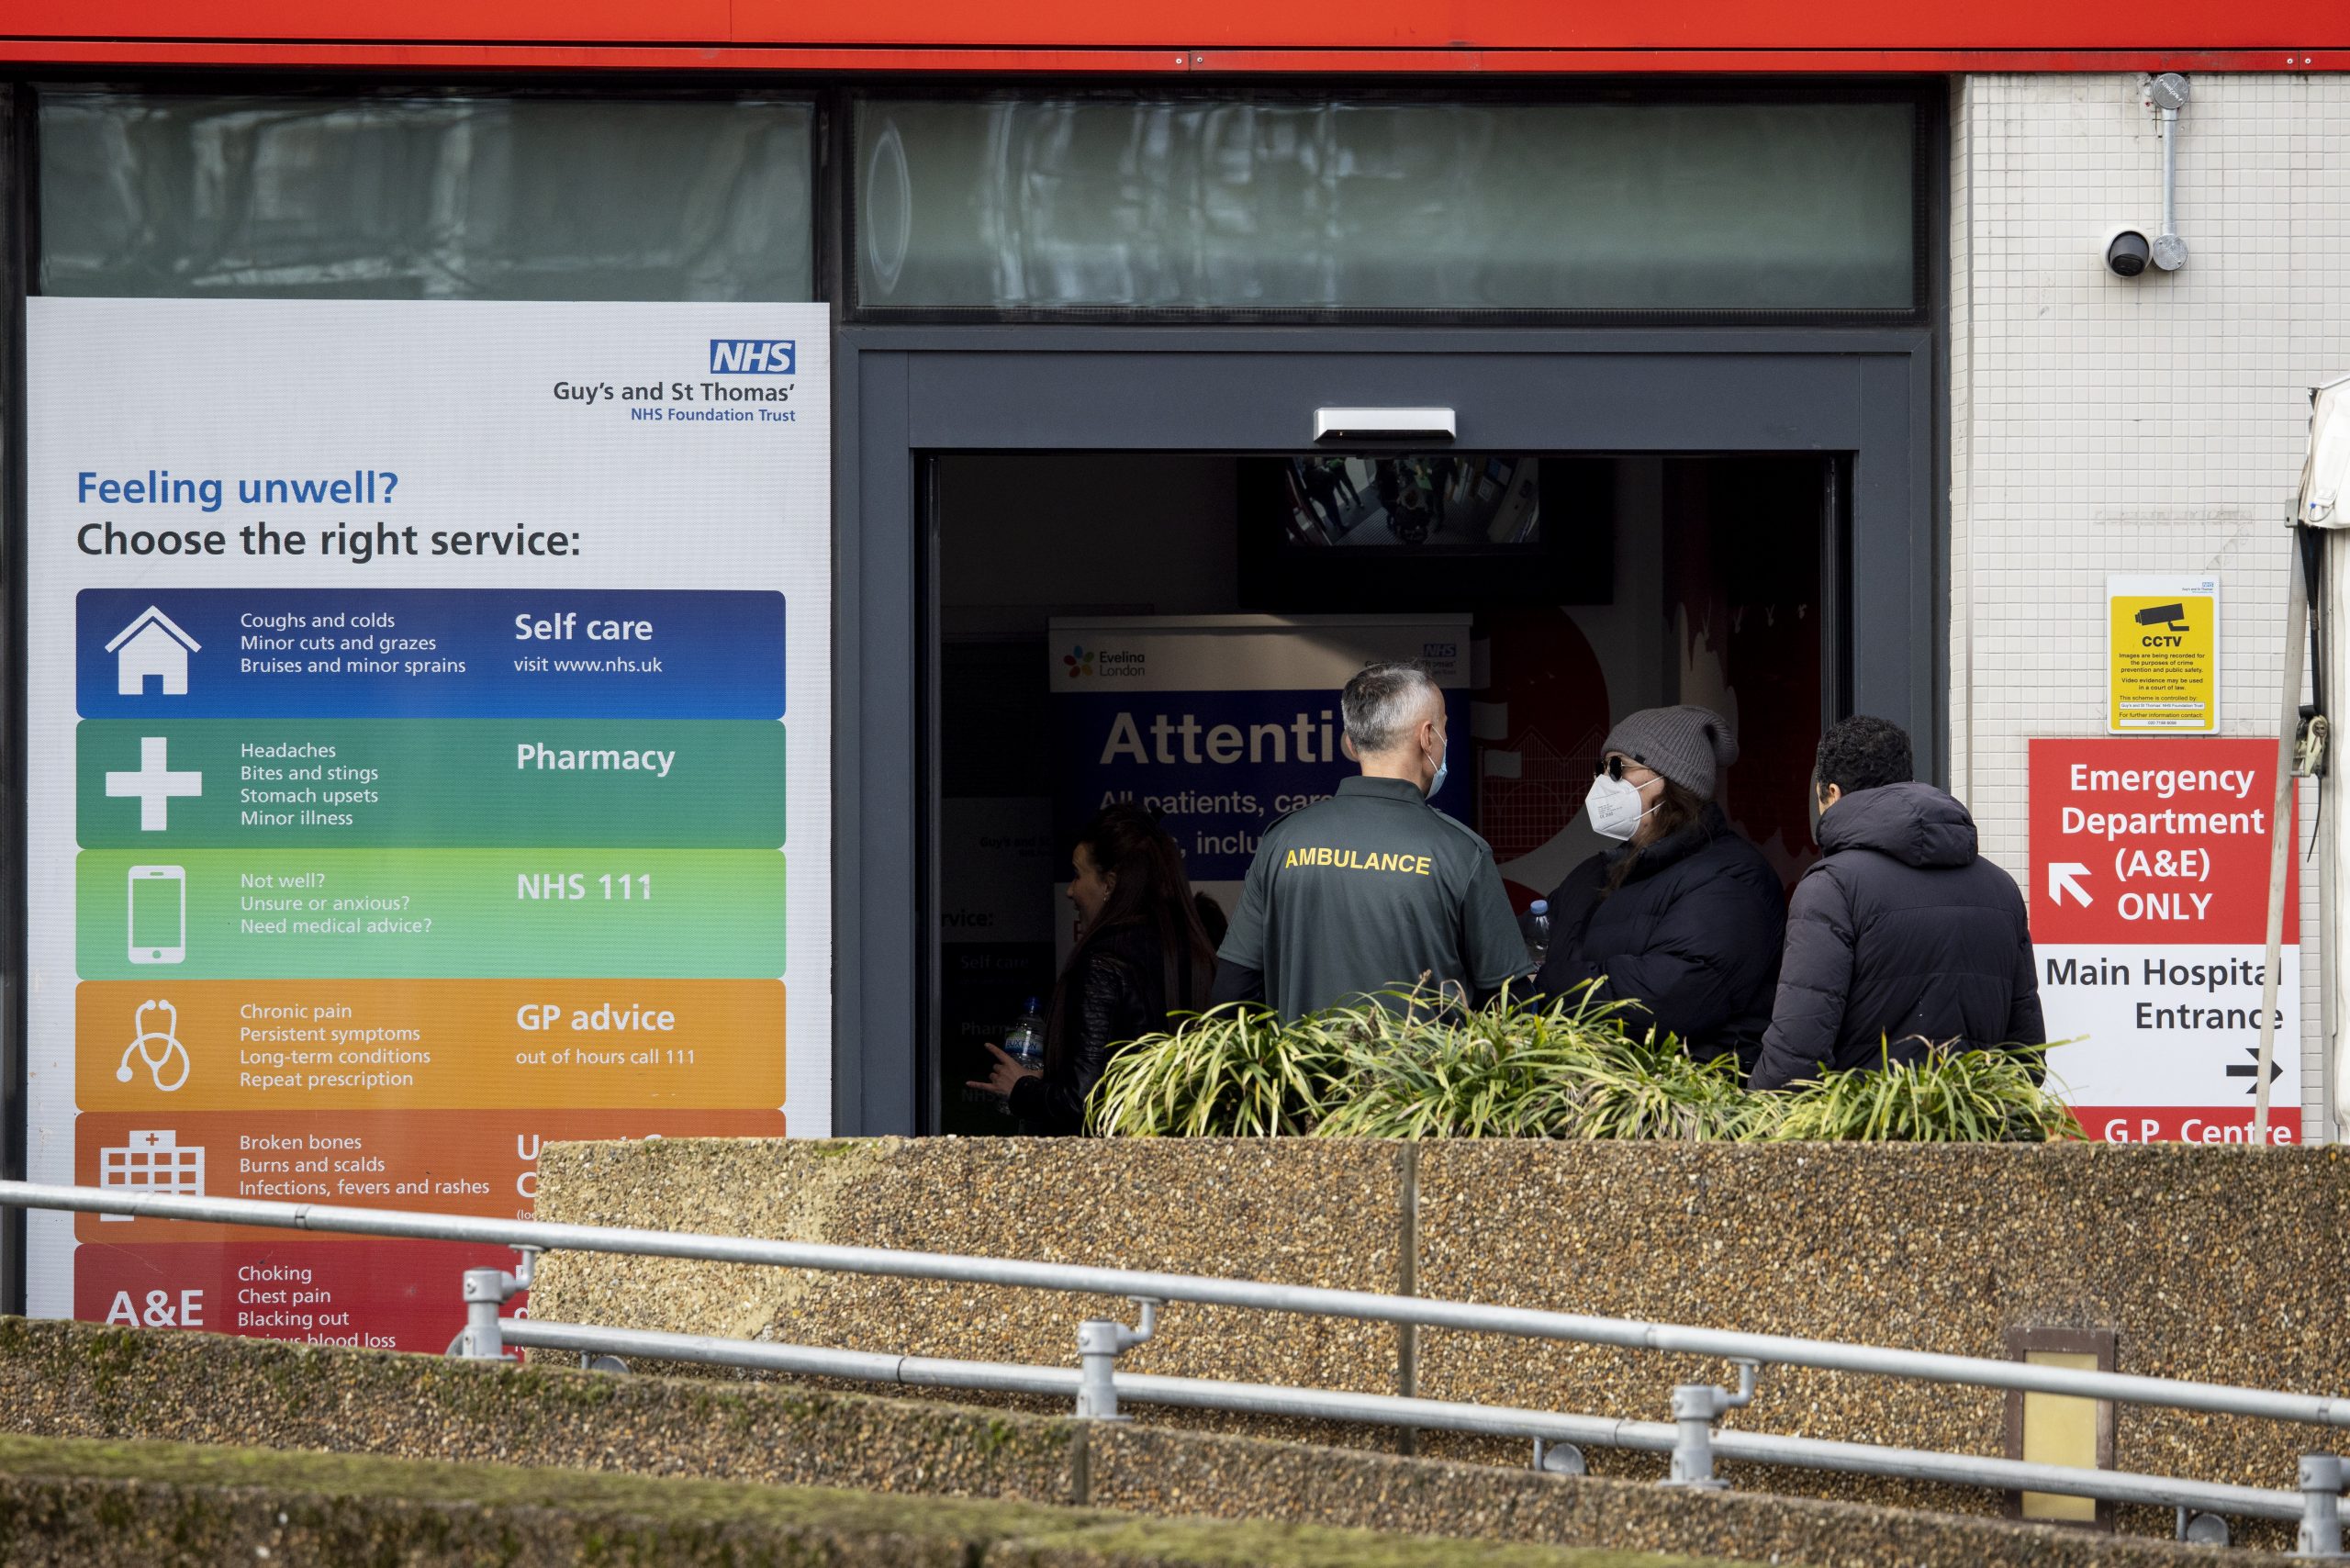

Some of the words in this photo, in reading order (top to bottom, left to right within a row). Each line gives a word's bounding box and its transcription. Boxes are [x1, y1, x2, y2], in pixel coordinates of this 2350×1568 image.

[712, 342, 792, 372] NHS
[554, 381, 613, 406] Guy's
[622, 381, 663, 400] and
[672, 382, 692, 401] St
[700, 382, 794, 402] Thomas'
[631, 408, 662, 420] NHS
[667, 408, 755, 421] Foundation
[759, 409, 795, 422] Trust
[78, 470, 221, 512] Feeling
[240, 470, 397, 504] unwell?
[78, 521, 225, 555] Choose
[241, 521, 305, 554] the
[322, 521, 417, 564] right
[432, 522, 578, 555] service:
[241, 612, 306, 633] Coughs
[312, 612, 345, 628] and
[351, 612, 395, 628] colds
[515, 612, 576, 640] Self
[588, 621, 652, 641] care
[241, 635, 292, 650] Minor
[300, 636, 334, 650] cuts
[341, 634, 374, 650] and
[380, 639, 435, 655] grazes
[1426, 644, 1455, 655] NHS
[2143, 636, 2181, 647] CCTV
[241, 657, 301, 673] Bruises
[308, 656, 341, 673] and
[348, 657, 397, 673] minor
[405, 657, 465, 678] sprains
[515, 655, 549, 673] visit
[554, 656, 662, 674] www.nhs.uk
[1100, 652, 1146, 664] Evelina
[1100, 666, 1146, 678] London
[241, 743, 336, 757] Headaches
[518, 742, 674, 778] Pharmacy
[241, 766, 283, 780] Bites
[289, 765, 321, 780] and
[328, 765, 378, 785] stings
[2071, 764, 2252, 799] Emergency
[241, 788, 316, 803] Stomach
[323, 790, 378, 806] upsets
[241, 811, 294, 825] Minor
[301, 810, 352, 825] illness
[2062, 806, 2263, 842] Department
[1197, 831, 1262, 855] inclu
[1285, 846, 1431, 876] AMBULANCE
[2116, 848, 2209, 882] (A&E)
[241, 874, 273, 888] Not
[278, 873, 325, 888] well?
[518, 874, 585, 900] NHS
[599, 874, 650, 900] 111
[241, 896, 302, 911] Unsure
[308, 899, 326, 911] or
[333, 896, 410, 912] anxious?
[2118, 893, 2211, 920] ONLY
[241, 918, 287, 934] Need
[294, 917, 361, 934] medical
[366, 917, 432, 935] advice?
[941, 909, 993, 927] rvice:
[2047, 958, 2129, 985] Main
[2143, 958, 2282, 993] Hospital
[241, 1003, 308, 1019] Chronic
[314, 1003, 352, 1022] pain
[518, 1004, 560, 1030] GP
[572, 1002, 674, 1031] advice
[241, 1025, 325, 1041] Persistent
[332, 1026, 420, 1047] symptoms
[241, 1049, 330, 1069] Long-term
[339, 1049, 431, 1065] conditions
[516, 1050, 545, 1064] out
[552, 1048, 570, 1064] of
[576, 1048, 624, 1064] hours
[631, 1048, 659, 1064] call
[667, 1049, 694, 1064] 111
[241, 1071, 301, 1091] Repeat
[308, 1070, 413, 1091] prescription
[241, 1135, 302, 1149] Broken
[309, 1134, 362, 1149] bones
[2105, 1119, 2168, 1144] G.P.
[241, 1158, 289, 1172] Burns
[296, 1157, 329, 1172] and
[334, 1155, 385, 1172] scalds
[241, 1179, 330, 1197] Infections,
[339, 1178, 389, 1195] fevers
[397, 1178, 429, 1194] and
[436, 1177, 489, 1193] rashes
[238, 1265, 312, 1284] Choking
[238, 1288, 286, 1304] Chest
[293, 1287, 330, 1307] pain
[106, 1290, 204, 1327] A&E
[239, 1310, 312, 1330] Blacking
[319, 1312, 349, 1326] out
[308, 1332, 358, 1349] blood
[364, 1332, 396, 1349] loss
